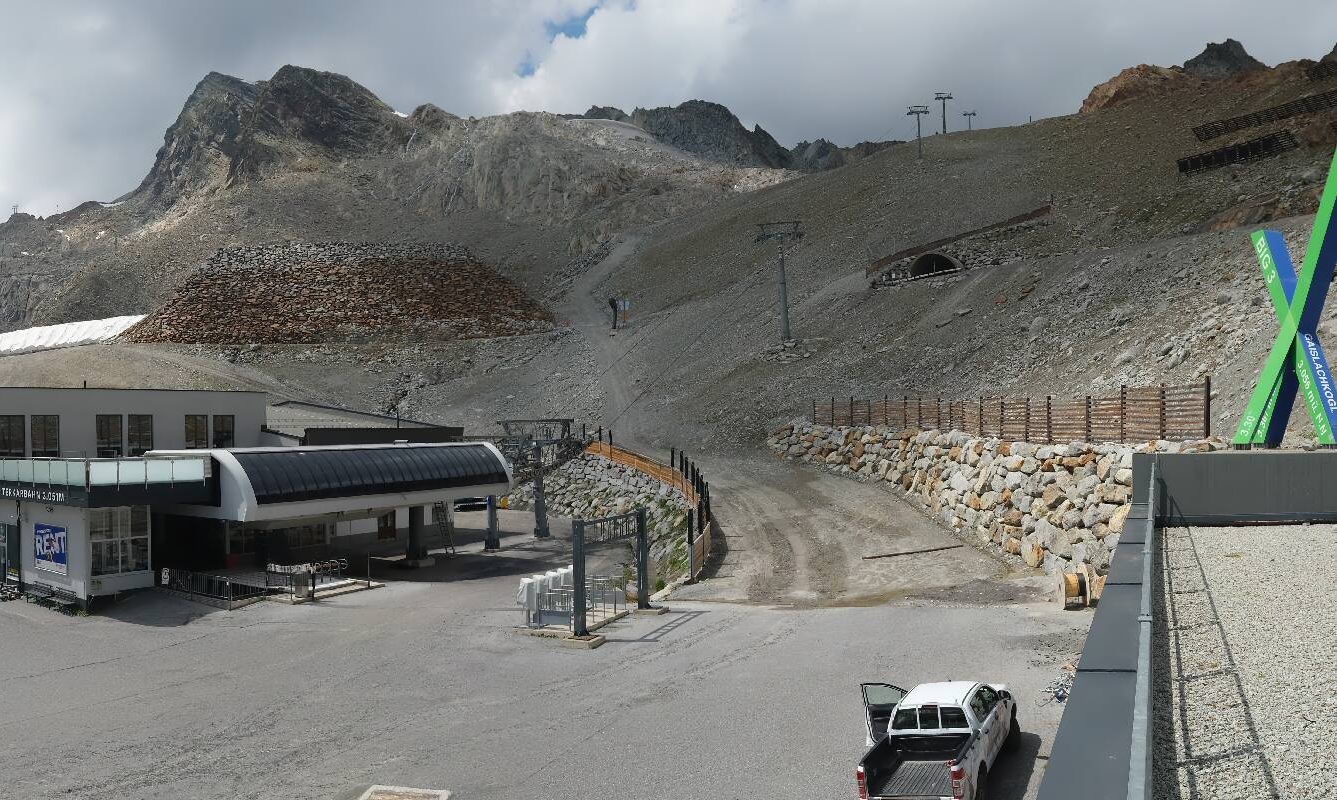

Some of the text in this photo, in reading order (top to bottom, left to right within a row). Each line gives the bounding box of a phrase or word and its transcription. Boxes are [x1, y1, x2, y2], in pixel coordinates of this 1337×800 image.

[1255, 236, 1276, 284] BIG 3
[1304, 333, 1337, 414] GAISLACHKOGL
